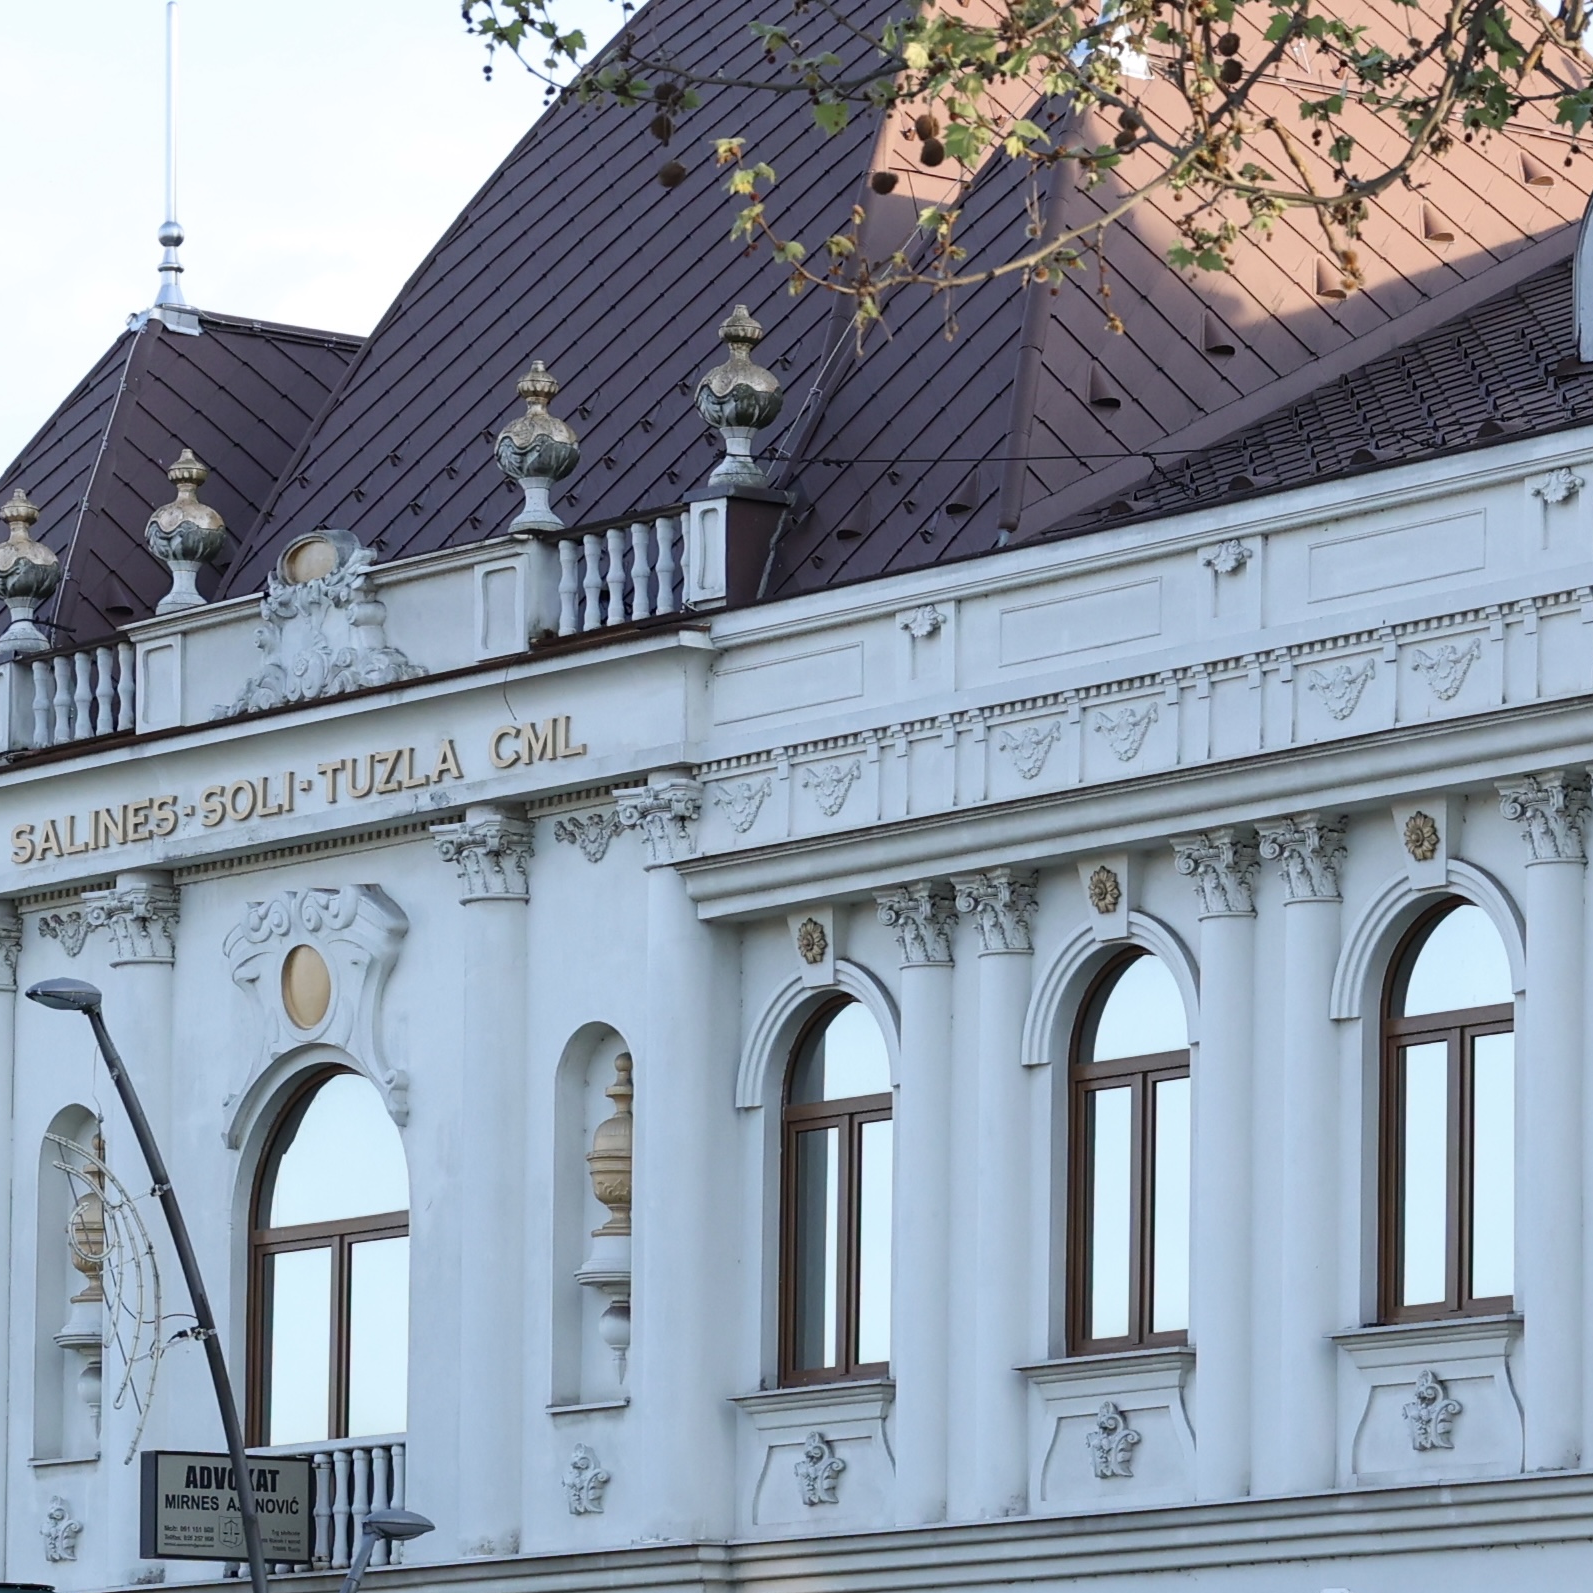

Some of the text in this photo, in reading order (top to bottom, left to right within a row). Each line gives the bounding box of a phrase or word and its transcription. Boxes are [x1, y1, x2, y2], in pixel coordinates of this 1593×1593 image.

[10, 715, 586, 864] SALINES SOLI TUZLA CML
[165, 1494, 299, 1514] MIRNES AJNOVIĆ
